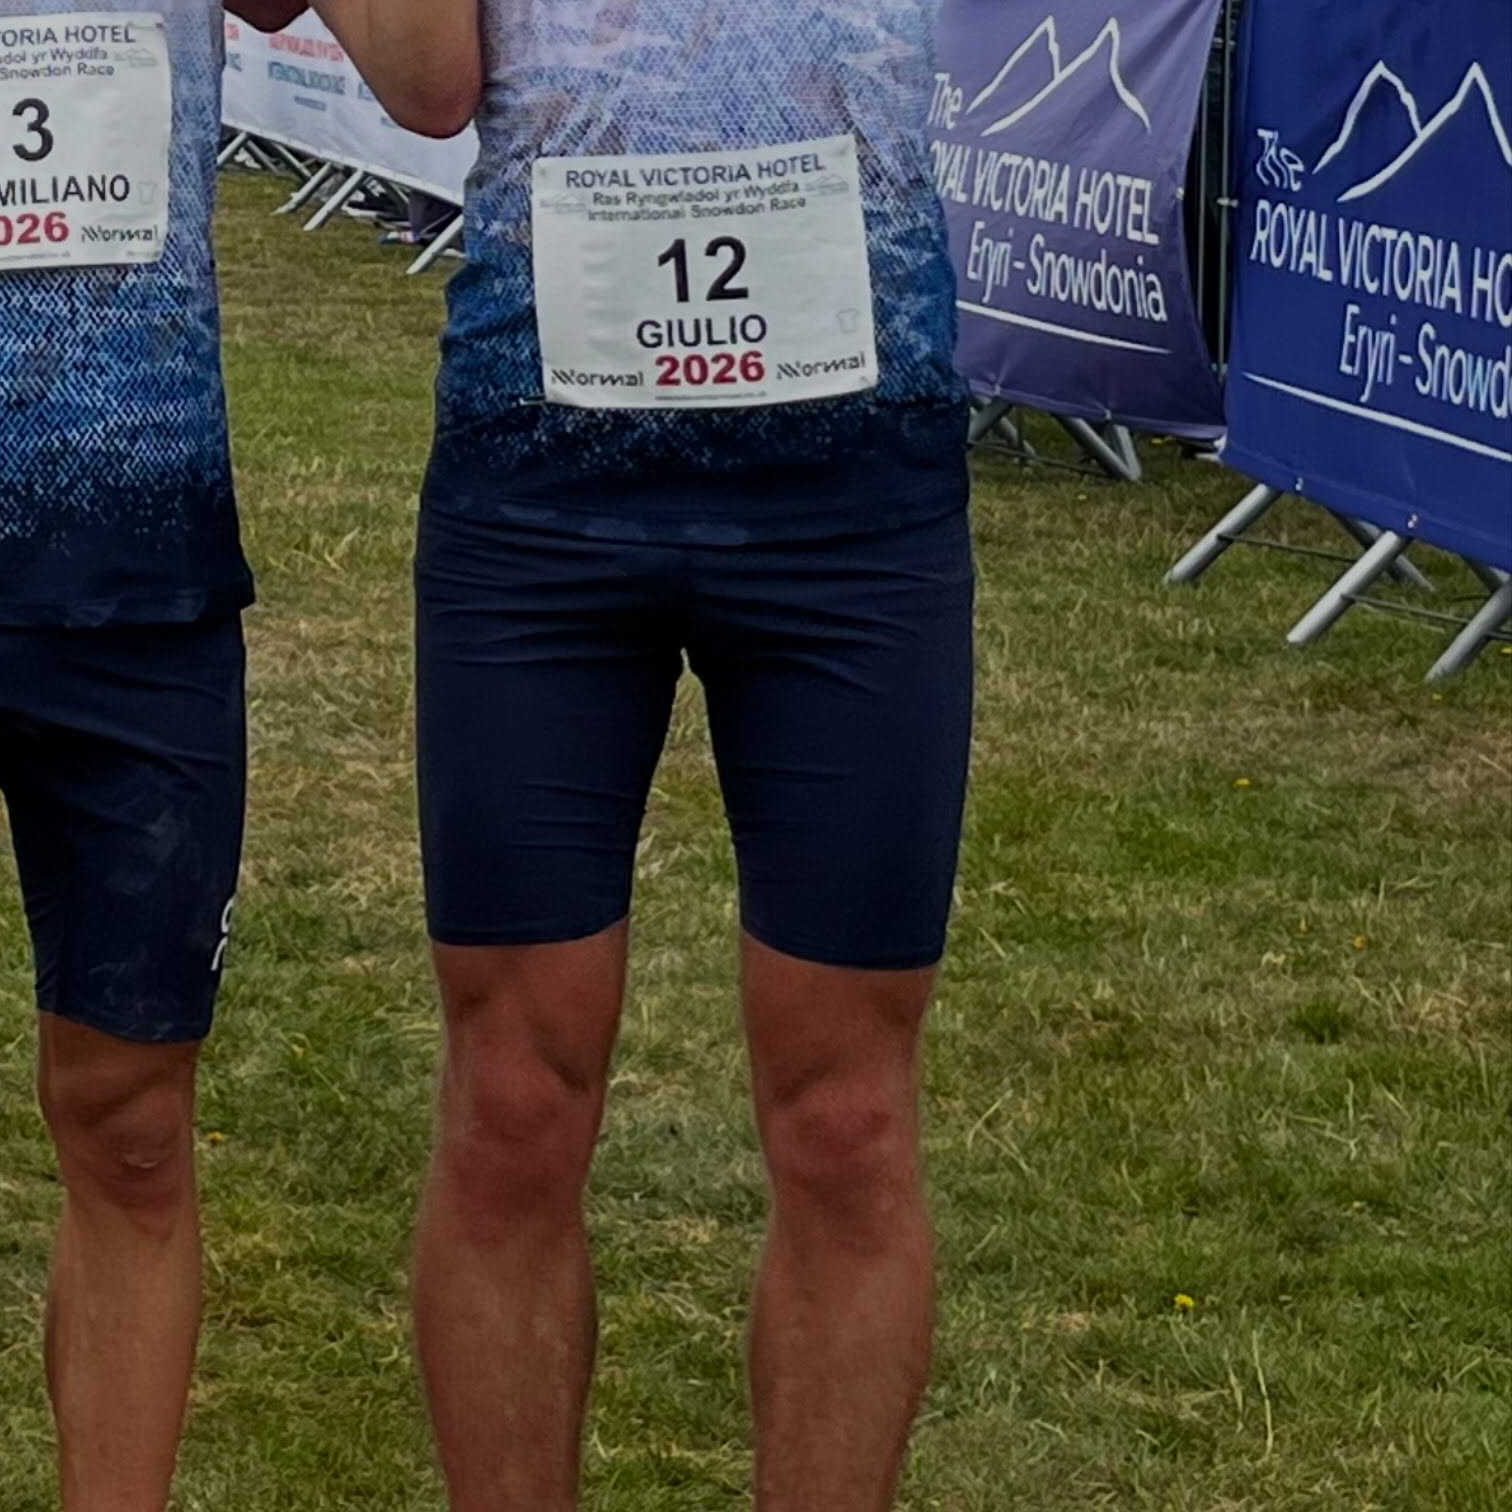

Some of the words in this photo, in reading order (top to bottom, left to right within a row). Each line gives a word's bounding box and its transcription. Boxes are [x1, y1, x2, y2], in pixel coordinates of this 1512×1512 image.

[65, 25, 136, 45] HOTEL
[0, 64, 72, 82] Snowdon
[77, 61, 115, 77] Race
[927, 72, 963, 130] The
[565, 167, 635, 189] ROYAL
[640, 162, 752, 187] VICTORIA
[757, 153, 825, 179] HOTEL
[1256, 128, 1305, 192] The
[588, 206, 686, 222] International
[691, 202, 765, 219] Snowdon
[770, 196, 807, 211] Race
[593, 192, 621, 206] Ras
[971, 148, 1071, 225] VICTORIA
[1074, 167, 1160, 246] HOTEL
[657, 235, 749, 303] 12
[967, 220, 1014, 303] Eryri
[1026, 233, 1168, 322] Snowdonia
[1250, 199, 1333, 282] ROYAL
[1338, 217, 1463, 315] VICTORIA
[636, 313, 768, 349] GIULIO
[654, 350, 766, 387] 2026
[1340, 303, 1397, 403] Eryri
[1415, 322, 1512, 419] Snowd
